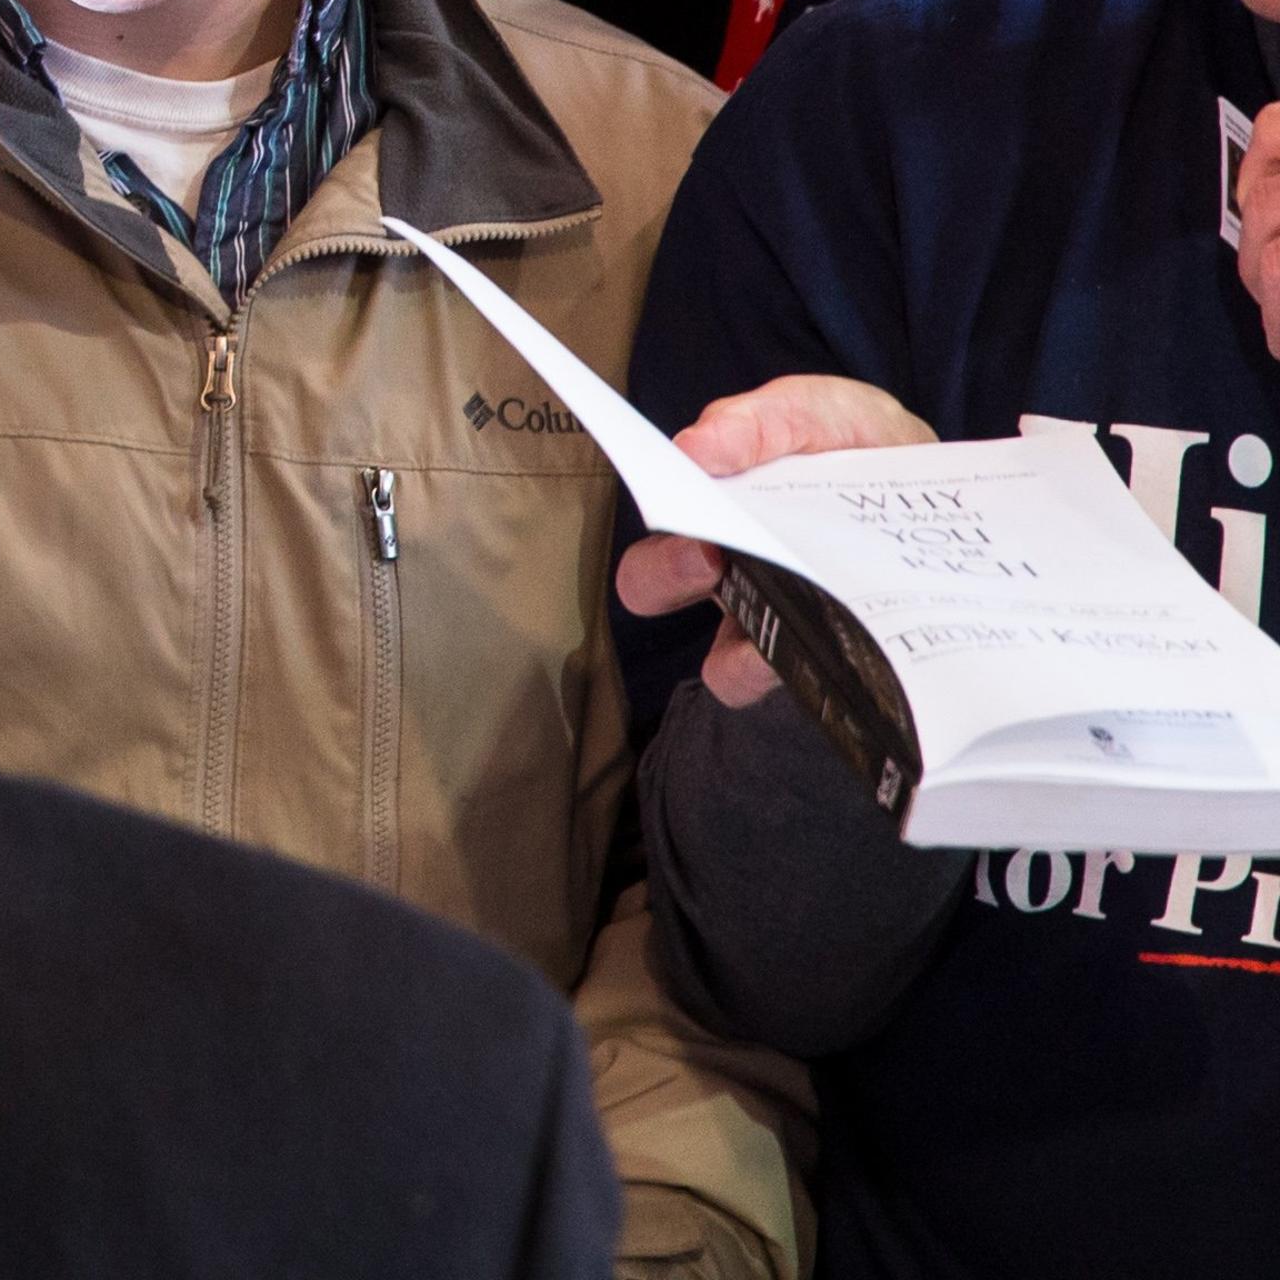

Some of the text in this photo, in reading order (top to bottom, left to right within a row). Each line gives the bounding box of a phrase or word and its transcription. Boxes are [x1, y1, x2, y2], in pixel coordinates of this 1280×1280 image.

[838, 489, 961, 509] WHY
[879, 527, 991, 544] YOU
[900, 554, 1038, 578] RICH
